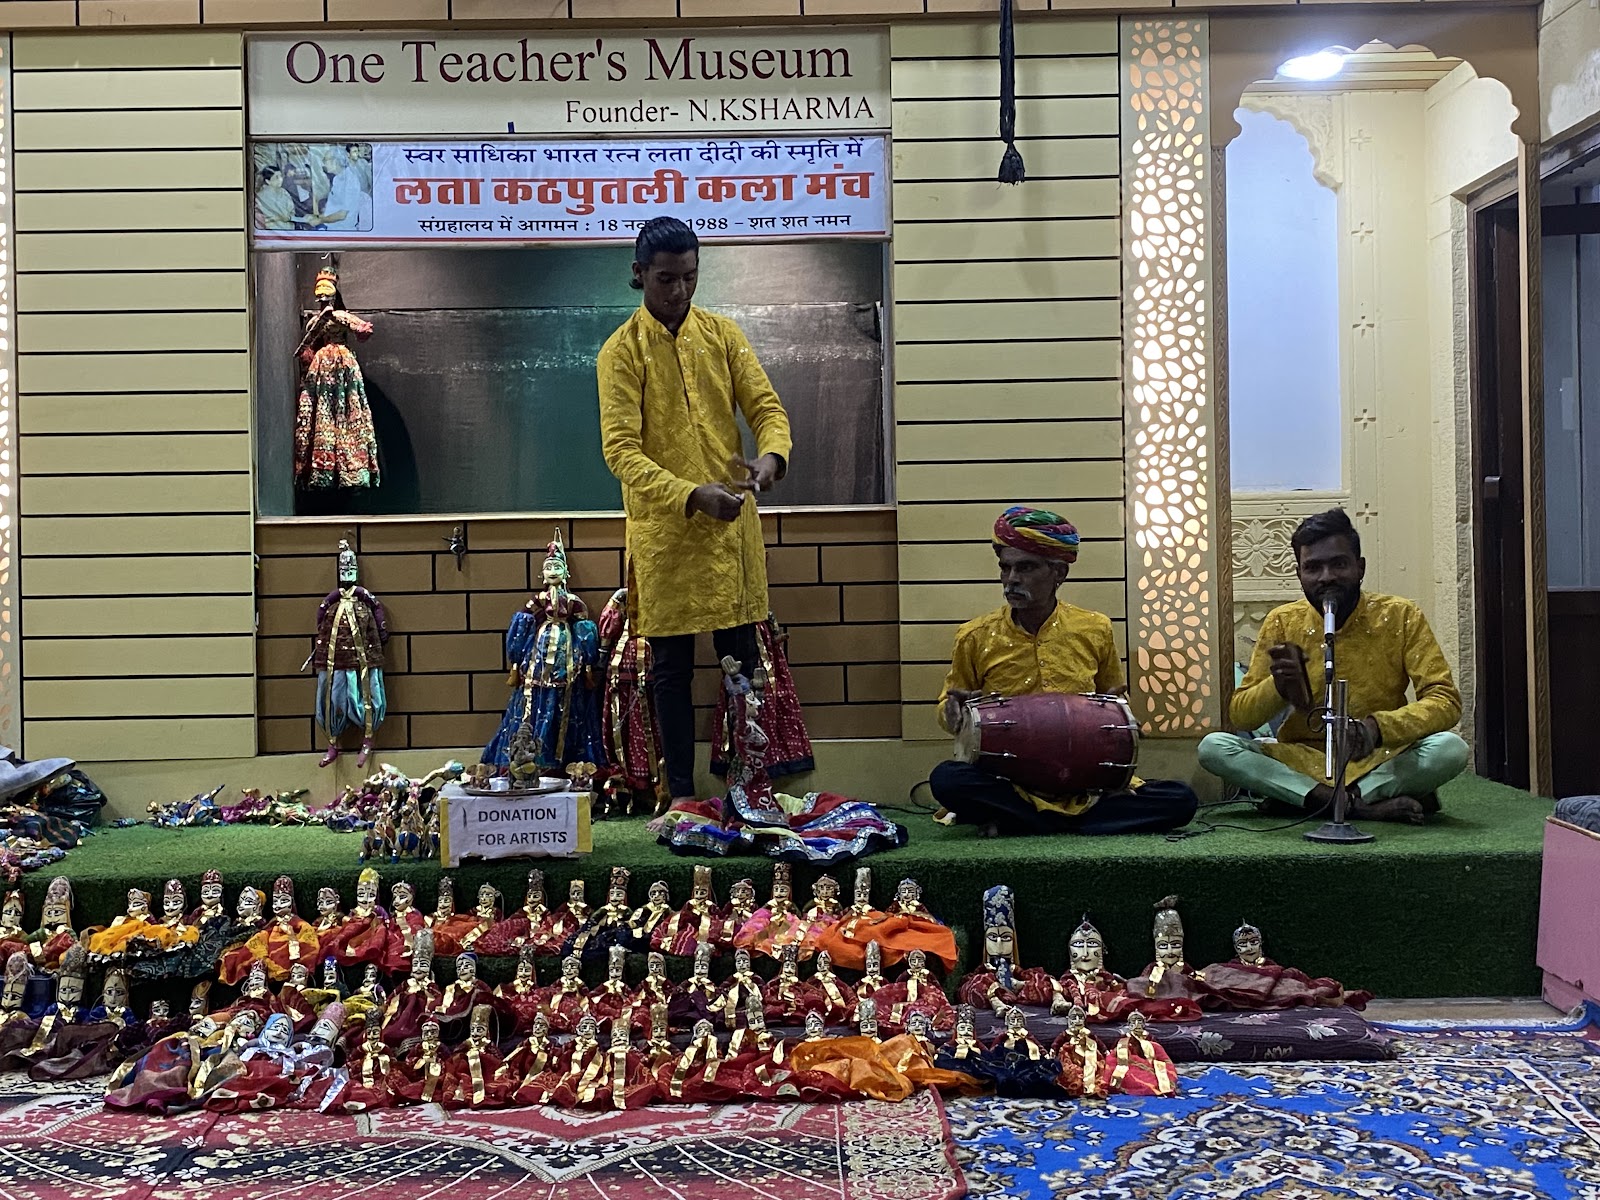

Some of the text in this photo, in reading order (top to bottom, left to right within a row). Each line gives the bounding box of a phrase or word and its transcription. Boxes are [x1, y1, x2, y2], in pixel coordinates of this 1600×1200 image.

[286, 37, 853, 84] One Teacher's Museum
[566, 99, 679, 123] Founder-
[403, 137, 864, 164] स्वर साधिका भारत रत्न लता दीदी की स्मृति में
[392, 163, 875, 215] लता कठपुतली कला मंच
[418, 215, 493, 233] संग्रहालय
[498, 215, 514, 232] में
[517, 219, 578, 232] आगमन
[597, 219, 618, 231] 18
[685, 217, 728, 231] 1988
[748, 216, 776, 230] शत
[781, 215, 809, 228] शत
[813, 214, 851, 227] नमन
[478, 807, 557, 823] DONATION
[477, 831, 568, 846] FOR ARTISTS
